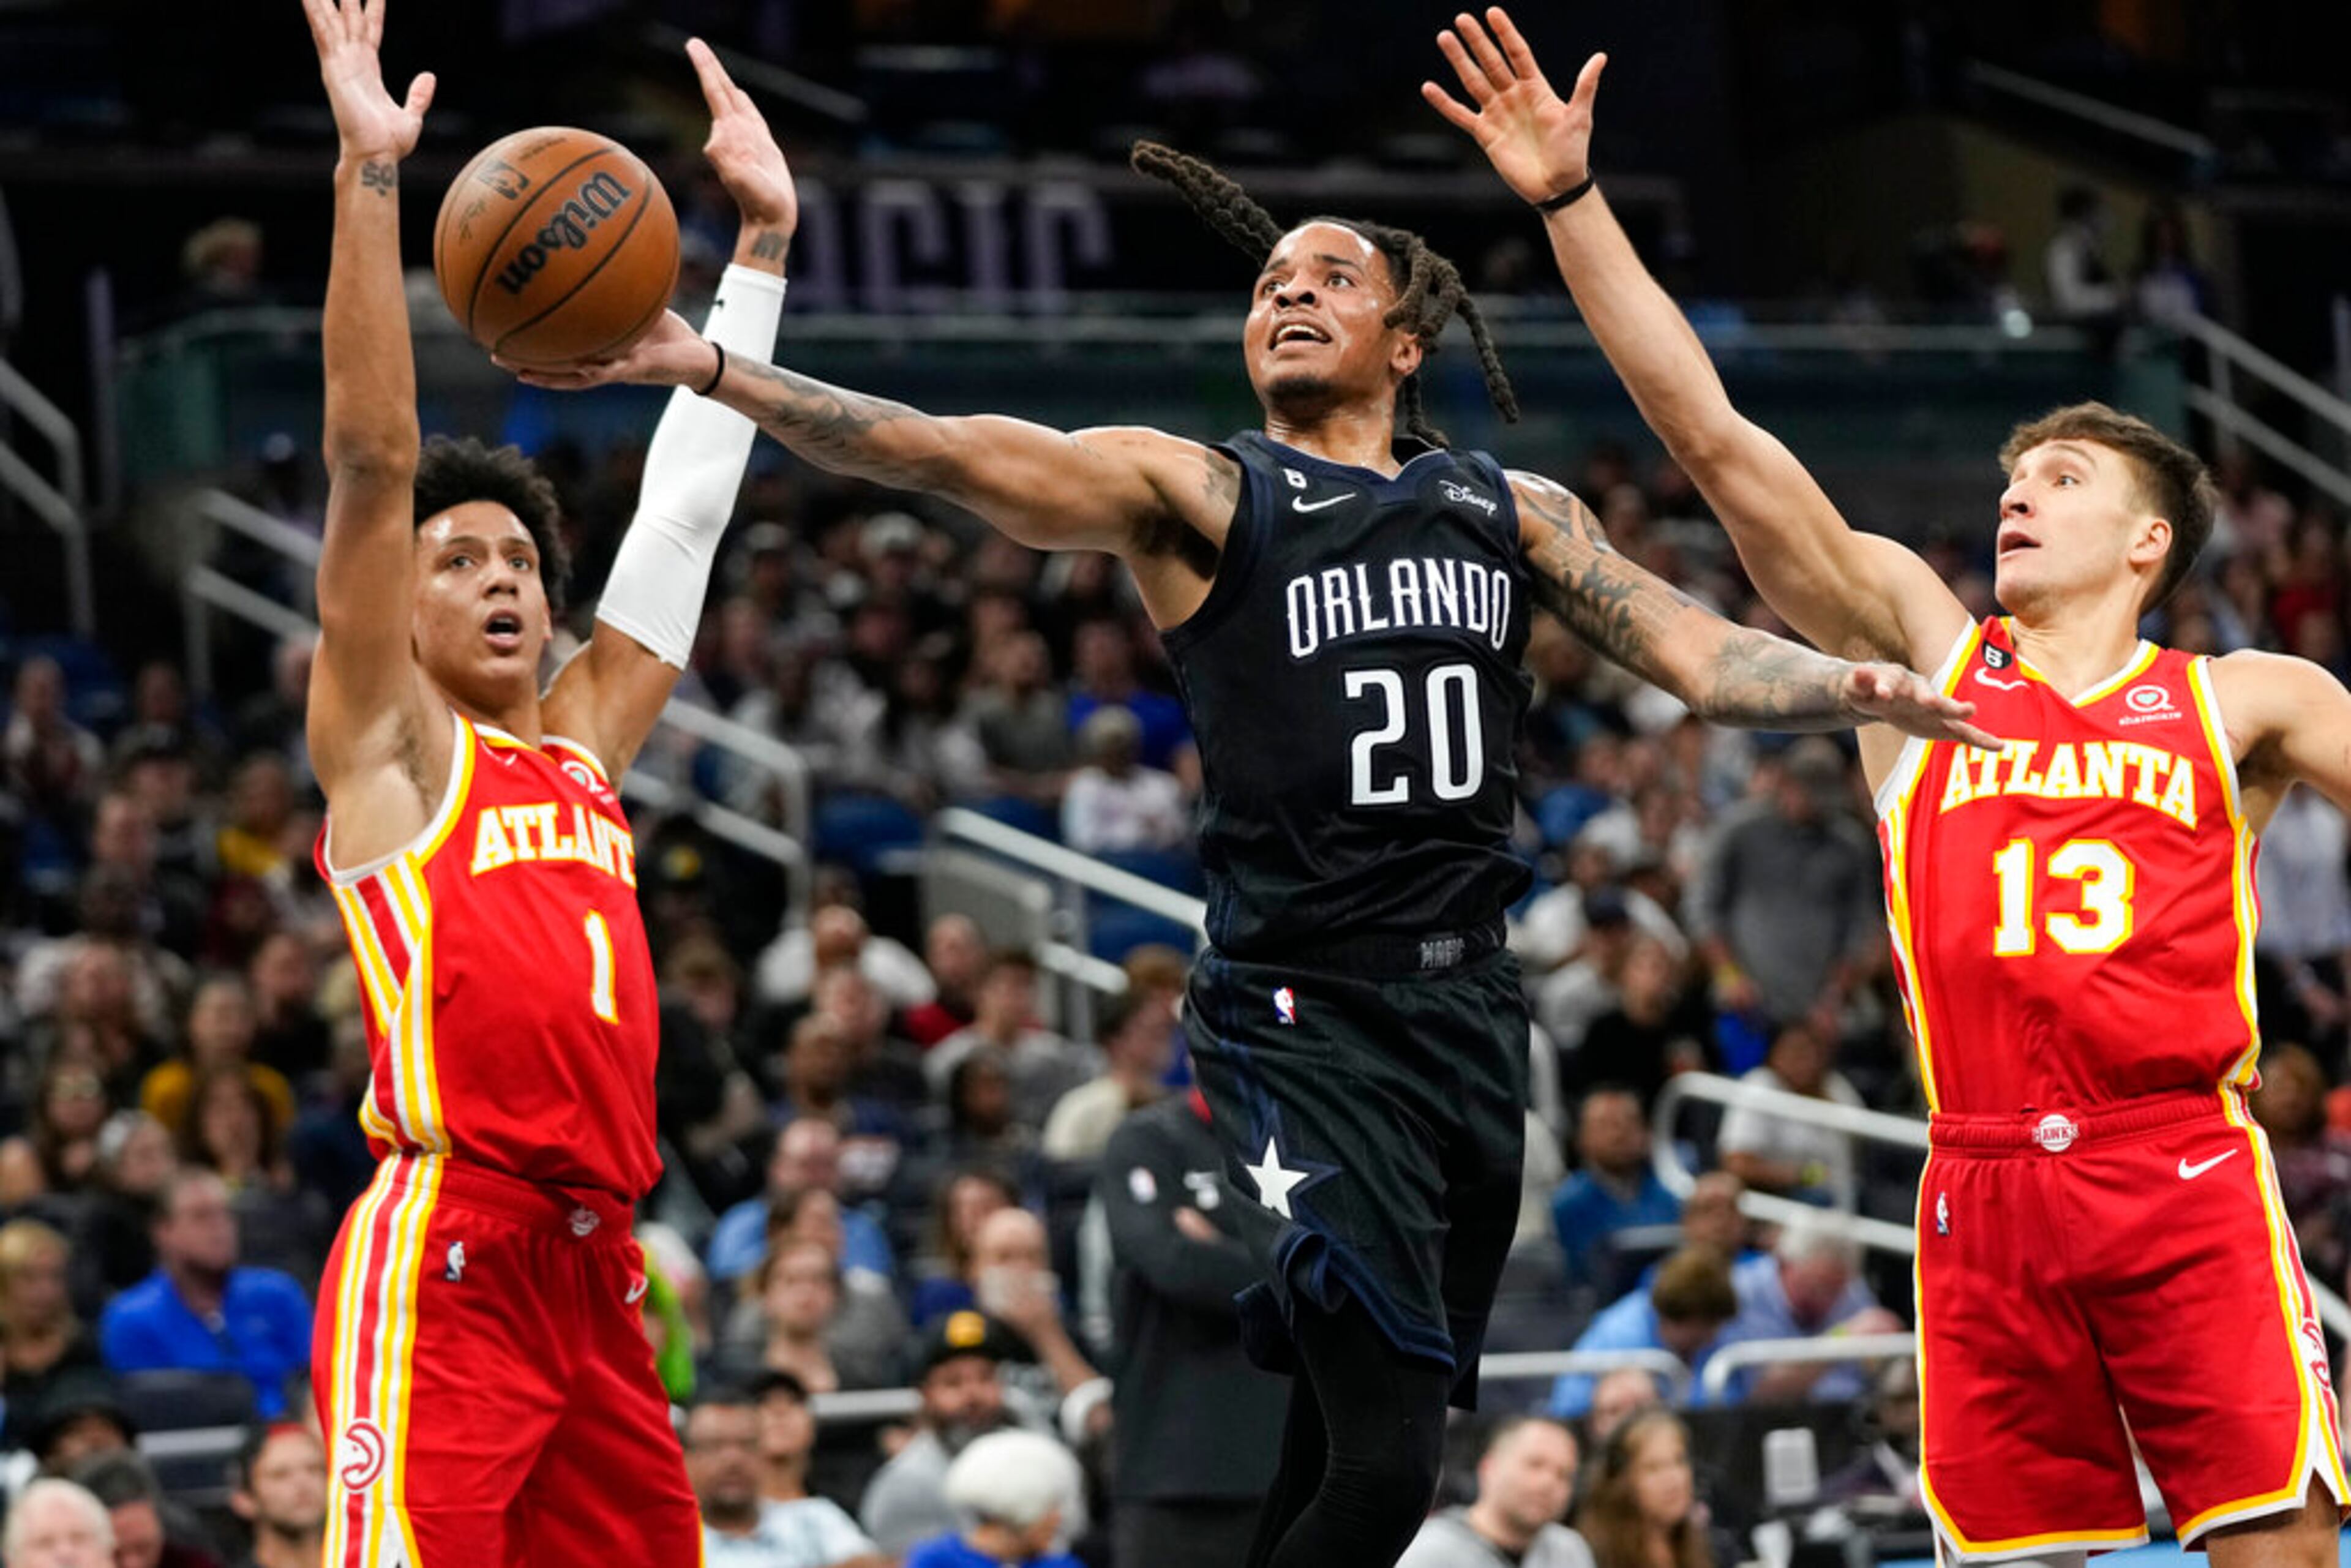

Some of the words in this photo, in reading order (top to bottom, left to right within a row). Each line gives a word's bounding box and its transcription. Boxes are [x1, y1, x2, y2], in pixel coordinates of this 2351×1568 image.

[495, 171, 632, 294] Wilson
[1438, 479, 1498, 516] Disney
[1286, 558, 1510, 659] ORLANDO
[1344, 664, 1484, 805] 20
[1940, 738, 2198, 831] ATLANTA
[470, 801, 637, 890] ATLANT
[1993, 837, 2135, 958] 13
[583, 909, 620, 1026] 1
[2031, 1123, 2080, 1144] HAWKS
